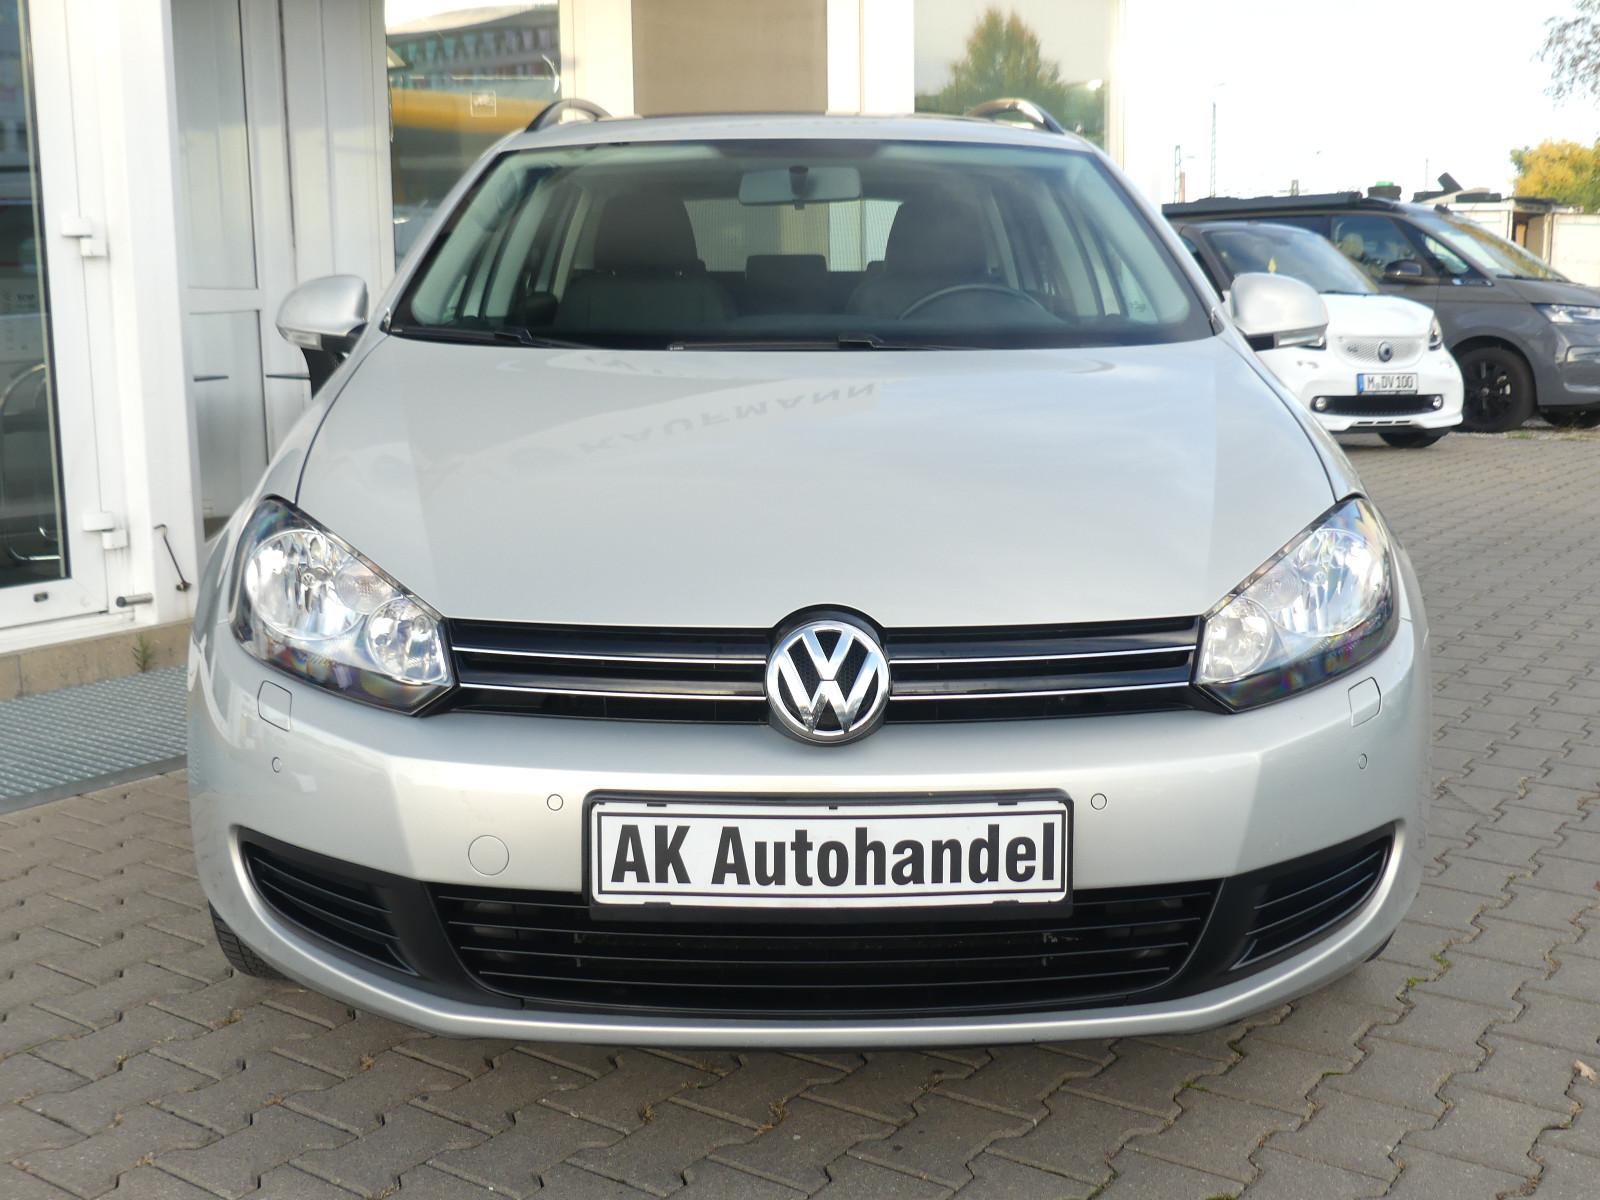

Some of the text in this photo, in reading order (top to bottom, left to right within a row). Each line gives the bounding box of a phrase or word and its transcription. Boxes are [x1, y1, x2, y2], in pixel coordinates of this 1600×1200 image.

[1396, 375, 1413, 388] 100
[769, 623, 889, 741] VW
[611, 823, 1054, 886] AK Autohandel
